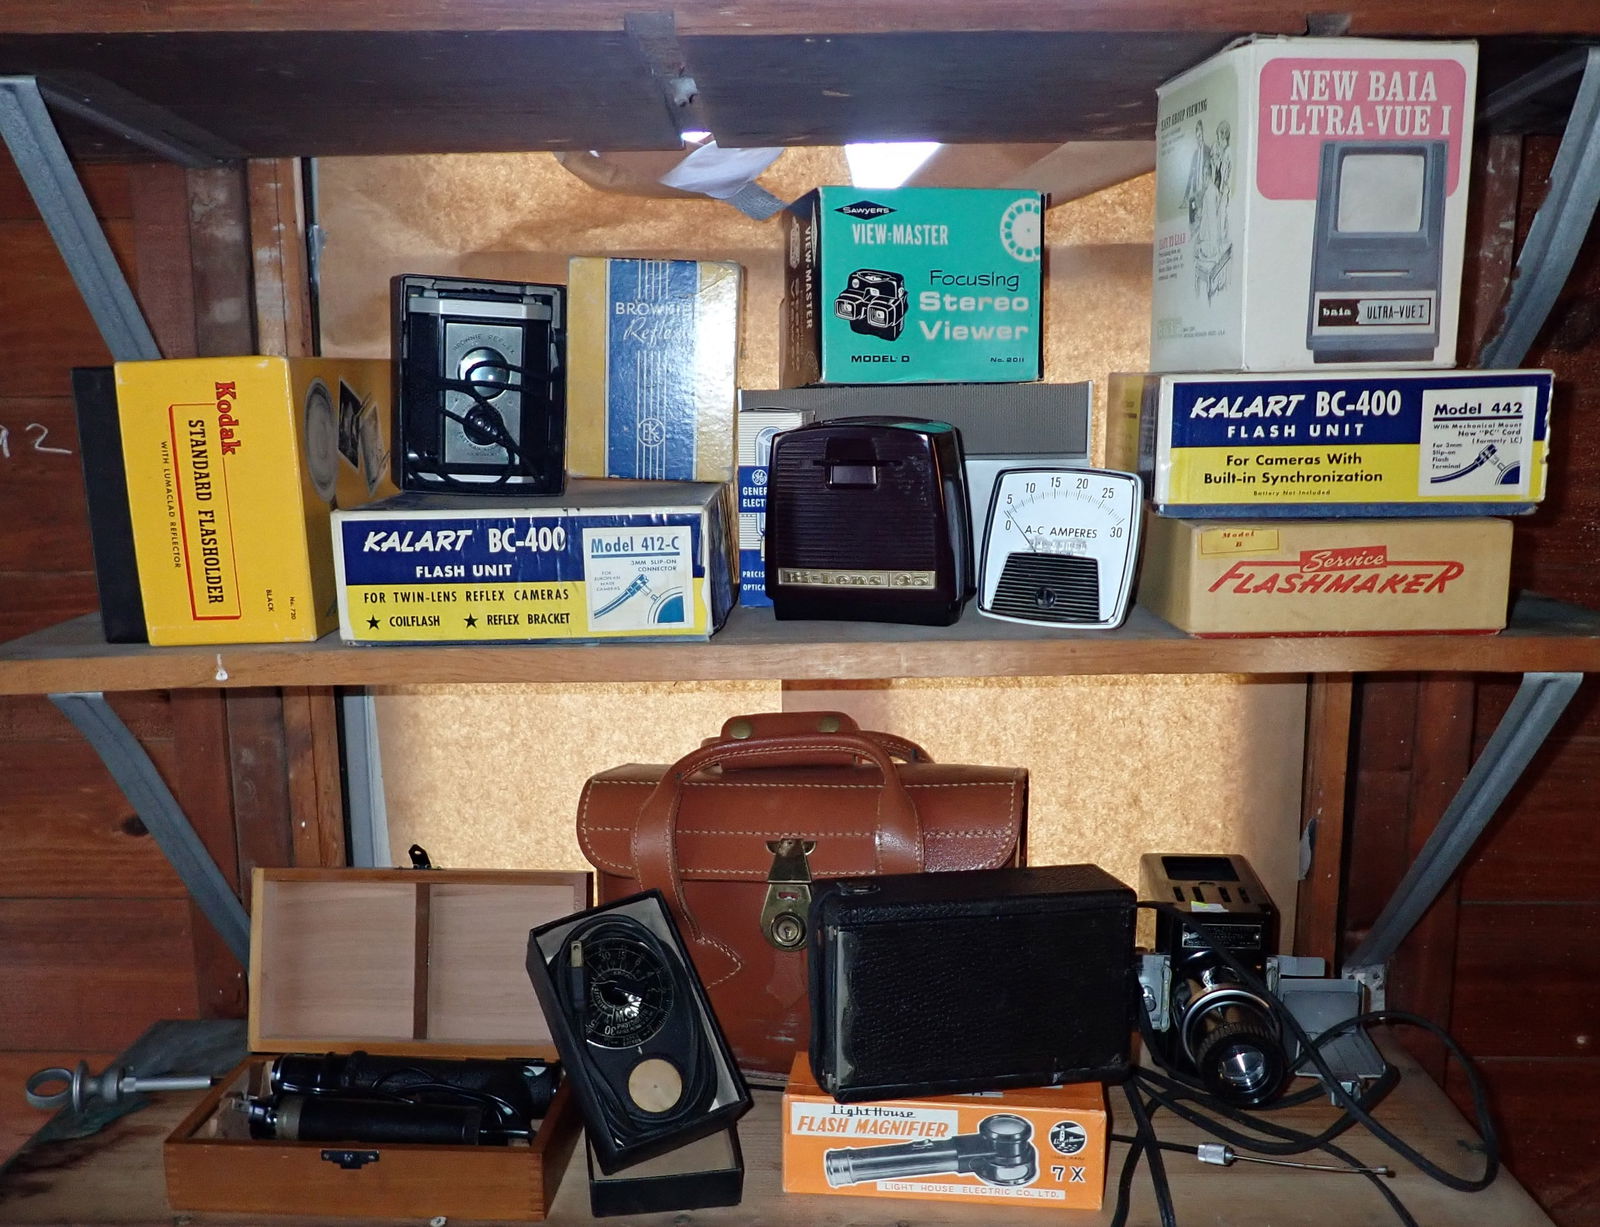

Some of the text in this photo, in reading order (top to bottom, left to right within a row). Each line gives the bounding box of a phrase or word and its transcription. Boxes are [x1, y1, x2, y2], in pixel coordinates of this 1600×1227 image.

[1290, 69, 1438, 101] NEW BAIA
[1270, 104, 1452, 136] ULTRA-VUE I
[852, 223, 949, 246] VIEW-MASTER
[930, 270, 1019, 292] Focusing
[919, 291, 1029, 312] Stereo
[1367, 305, 1425, 320] ULTRA-VUE I
[919, 320, 1029, 341] Viewer
[851, 355, 910, 363] MODEL D
[1190, 390, 1401, 419] KALART BC-400
[1434, 402, 1522, 416] Model 442
[215, 381, 242, 456] Kodak
[1227, 423, 1364, 438] FLASH UNIT
[1226, 452, 1362, 466] For Cameras With
[1051, 477, 1061, 487] 15
[1076, 479, 1089, 489] 20
[1204, 470, 1383, 485] Built-in Synchronization
[1025, 483, 1036, 493] 10
[1102, 488, 1114, 499] 25
[161, 441, 182, 568] WITH LUMACLAD REFLECTOR
[1006, 494, 1013, 505] 5
[189, 419, 224, 604] STANDARD FLASHOLDER
[1005, 520, 1012, 531] 0
[1024, 525, 1098, 538] A-C AMPERES
[1110, 527, 1122, 538] 30
[363, 527, 566, 553] KALART BC-400
[1222, 530, 1255, 538] Model
[591, 536, 680, 553] Model 412-C
[1303, 551, 1385, 572] Service
[416, 564, 512, 578] FLASH UNIT
[1207, 560, 1465, 594] FLASHMAKER
[265, 589, 275, 612] BLACK
[364, 588, 569, 603] FOR TWIN-LENS REFLEX CAMERAS
[389, 615, 440, 627] COILFLASH
[487, 612, 570, 626] REFLEX BRACKET
[797, 1116, 949, 1137] FLASH MAGNIFIER
[1051, 1166, 1084, 1181] 7 X
[885, 1183, 913, 1191] LIGHT
[921, 1184, 955, 1192] HOUSE
[963, 1186, 1010, 1195] ELECTRIC
[1038, 1190, 1060, 1198] LTD.
